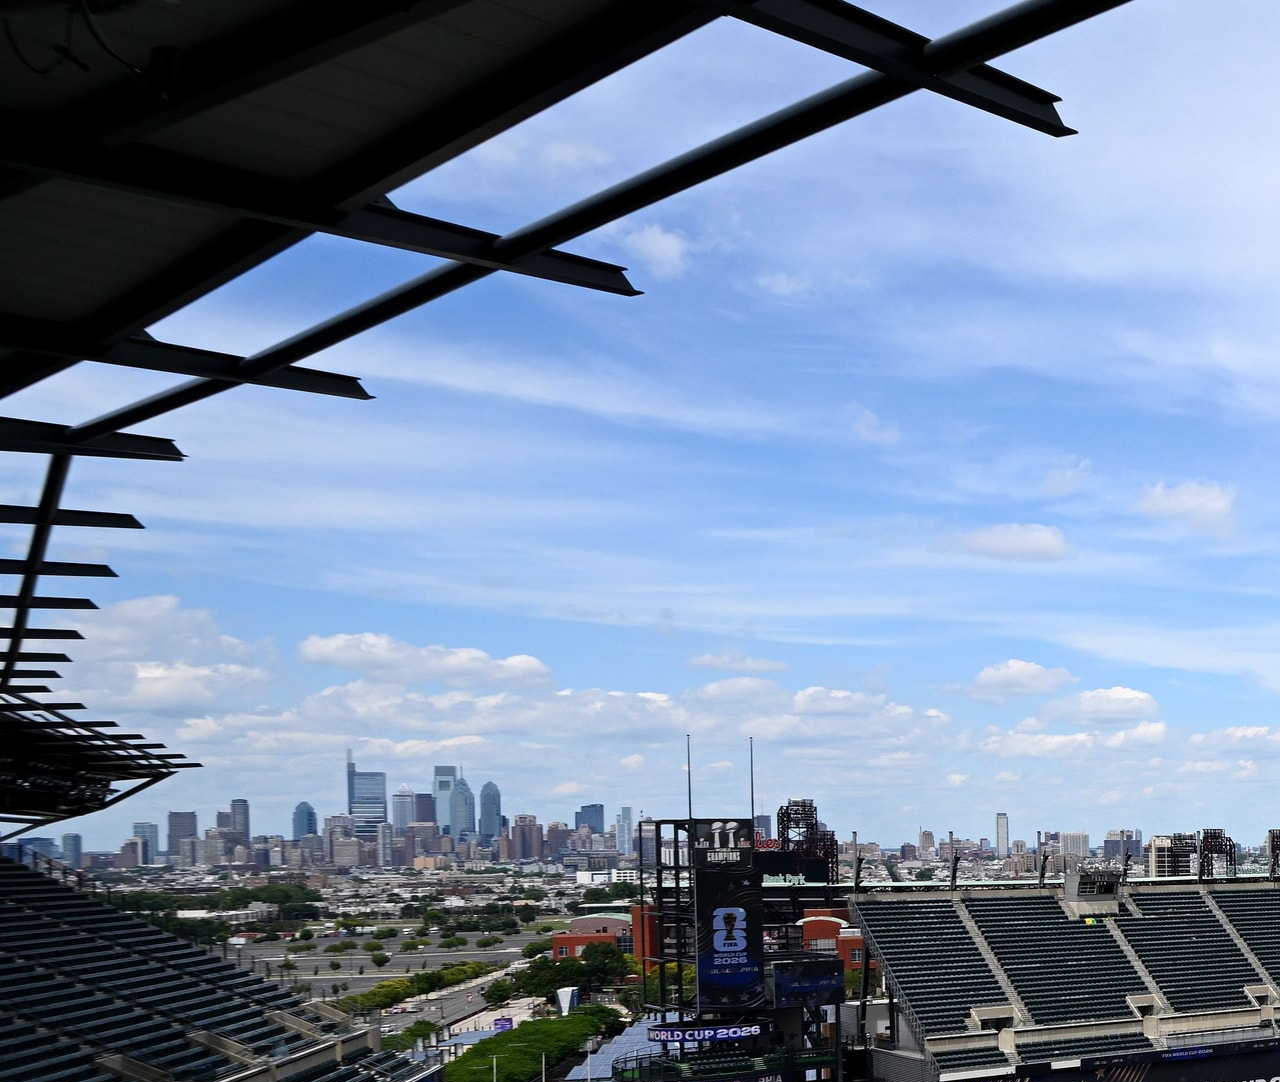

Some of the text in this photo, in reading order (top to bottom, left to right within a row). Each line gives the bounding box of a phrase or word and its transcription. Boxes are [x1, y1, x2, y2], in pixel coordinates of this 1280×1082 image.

[713, 956, 748, 965] 2026
[685, 1029, 714, 1040] CUP
[716, 1025, 761, 1039] 2026
